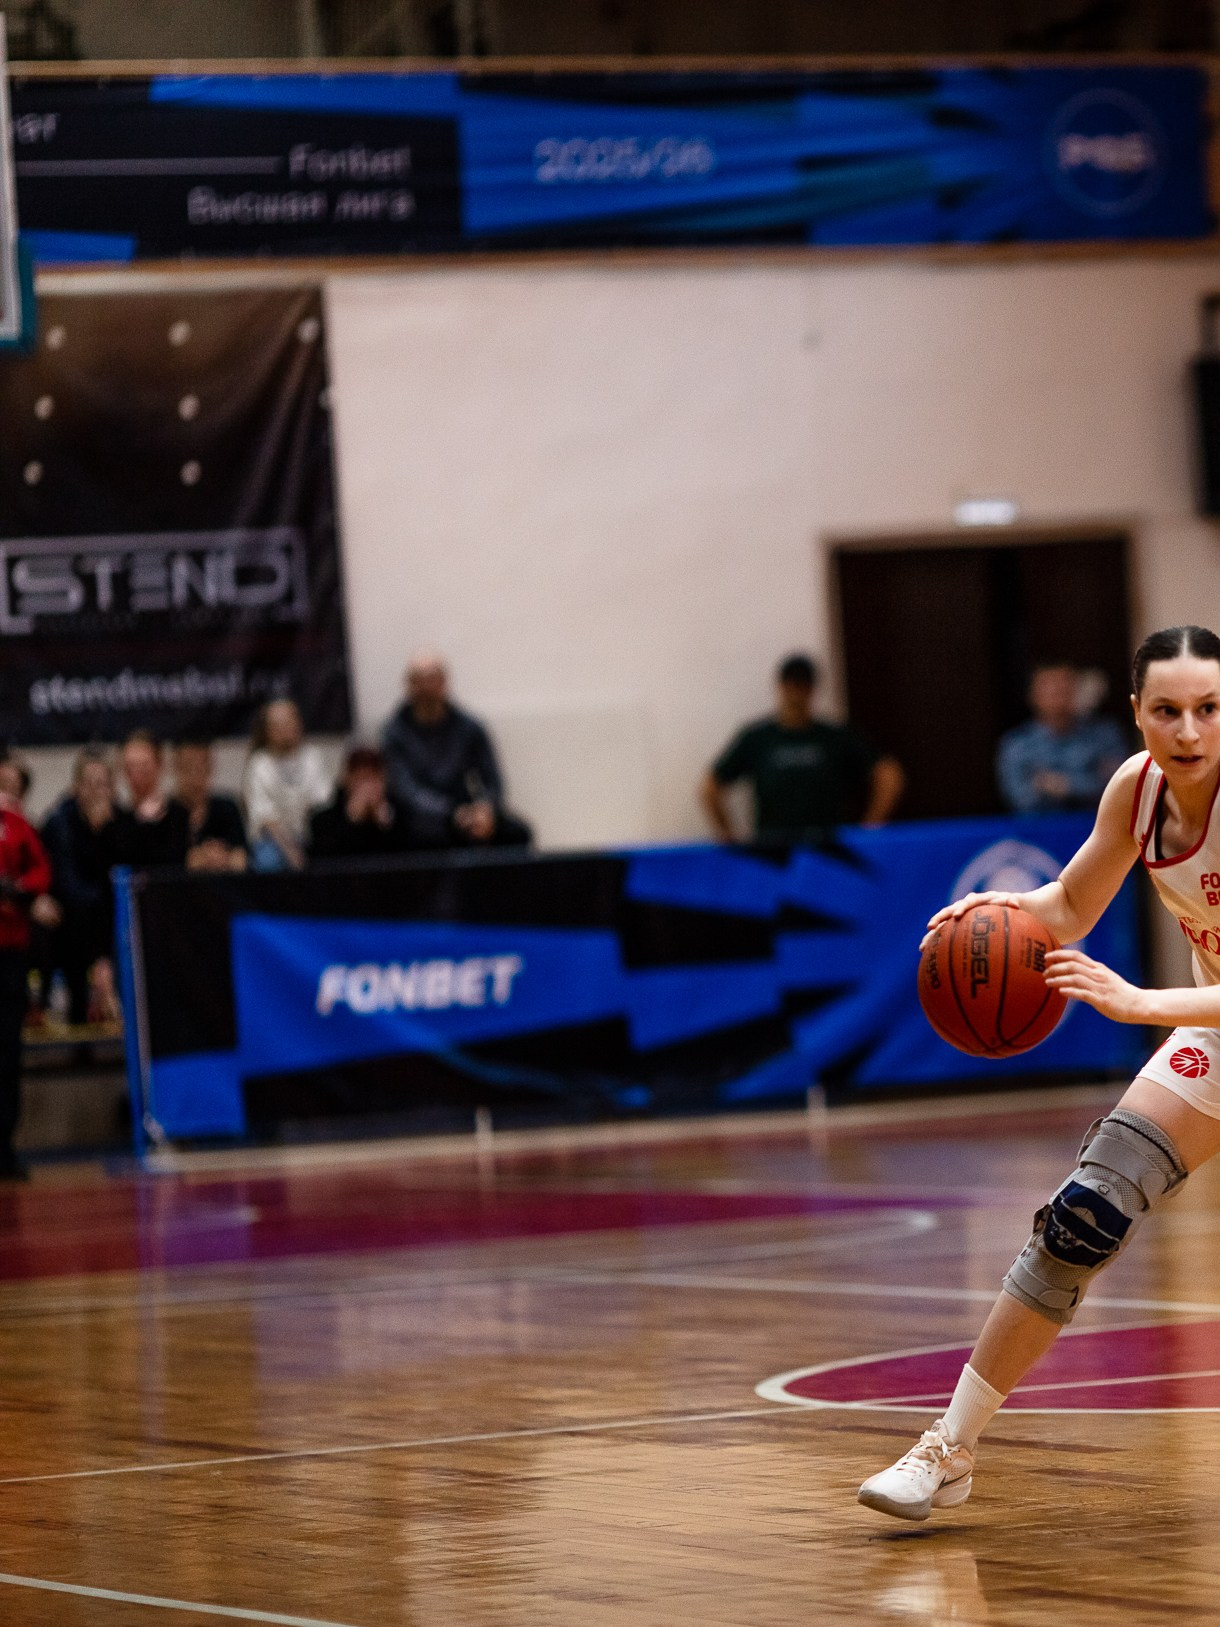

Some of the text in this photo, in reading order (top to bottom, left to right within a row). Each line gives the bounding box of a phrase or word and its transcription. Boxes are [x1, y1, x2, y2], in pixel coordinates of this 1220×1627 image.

[12, 548, 290, 614] STEND
[315, 954, 525, 1017] FONBET
[971, 911, 996, 998] JÖGEL
[1033, 940, 1047, 973] FIBA
